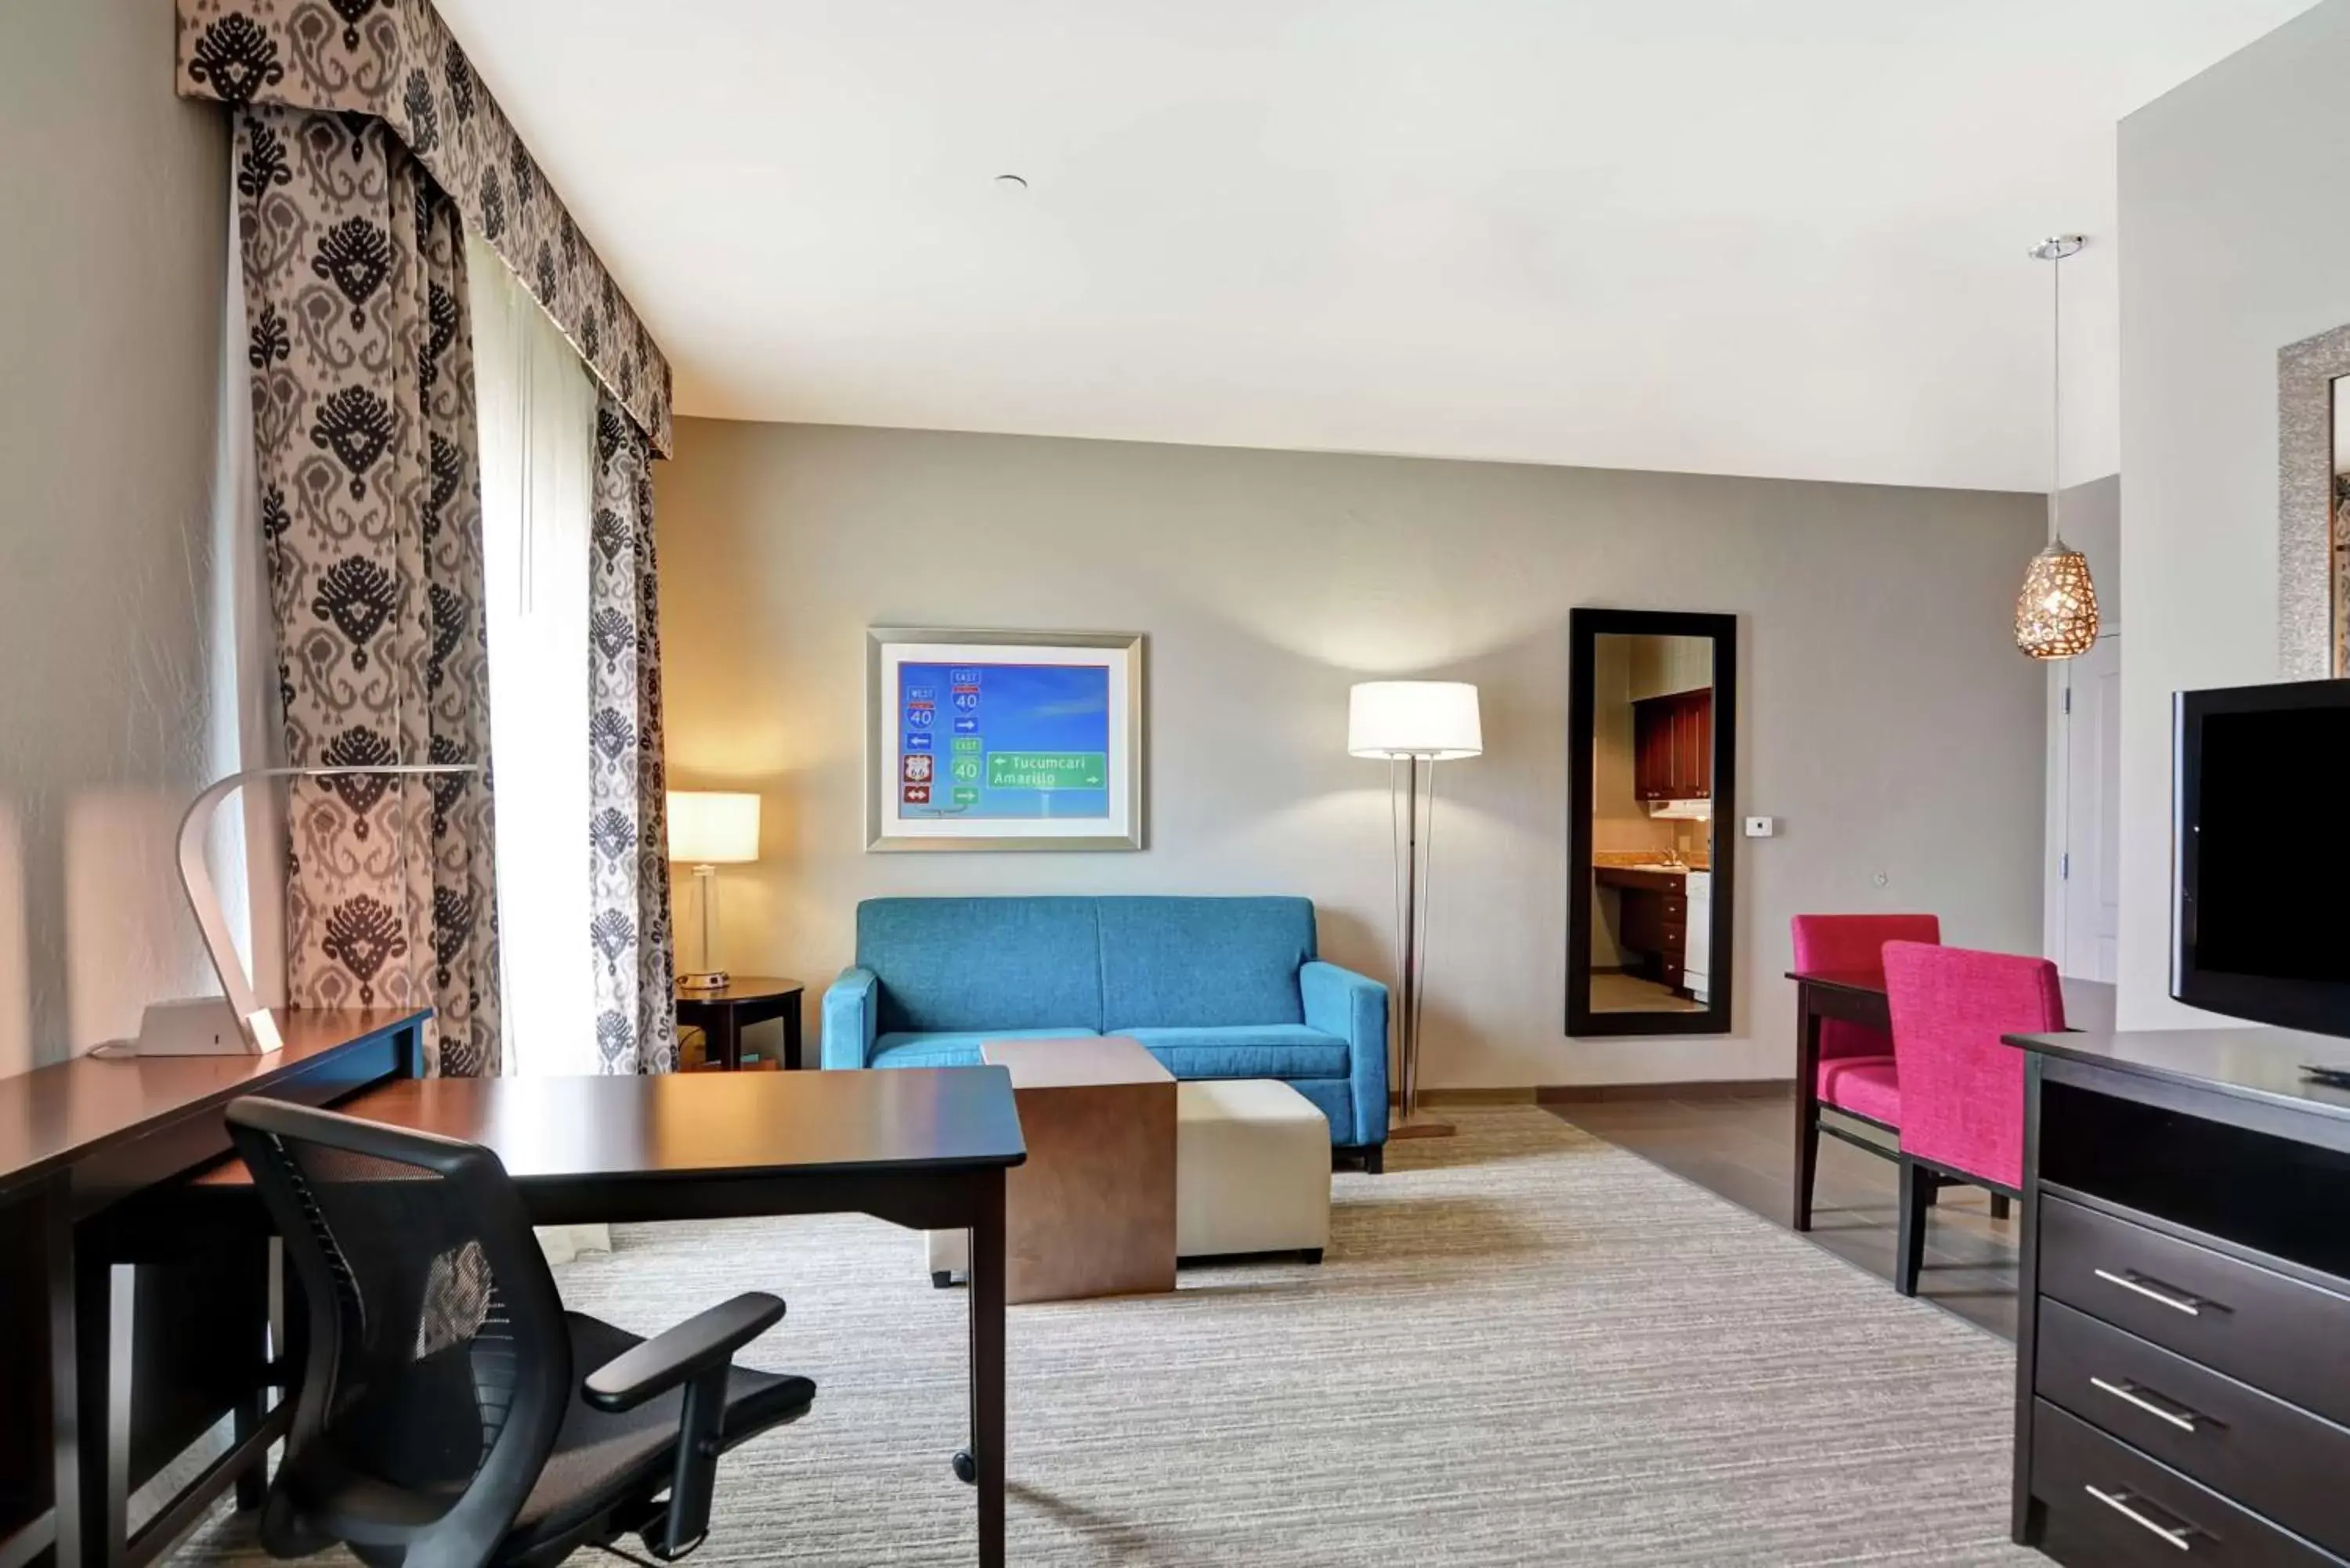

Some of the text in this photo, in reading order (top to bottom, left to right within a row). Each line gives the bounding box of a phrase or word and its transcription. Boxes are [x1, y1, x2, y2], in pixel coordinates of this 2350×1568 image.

[956, 695, 977, 707] 40
[910, 710, 931, 724] 40
[1013, 756, 1085, 769] Tucumcari
[911, 768, 925, 778] 66
[956, 764, 977, 778] 40
[994, 772, 1055, 786] Amarillo
